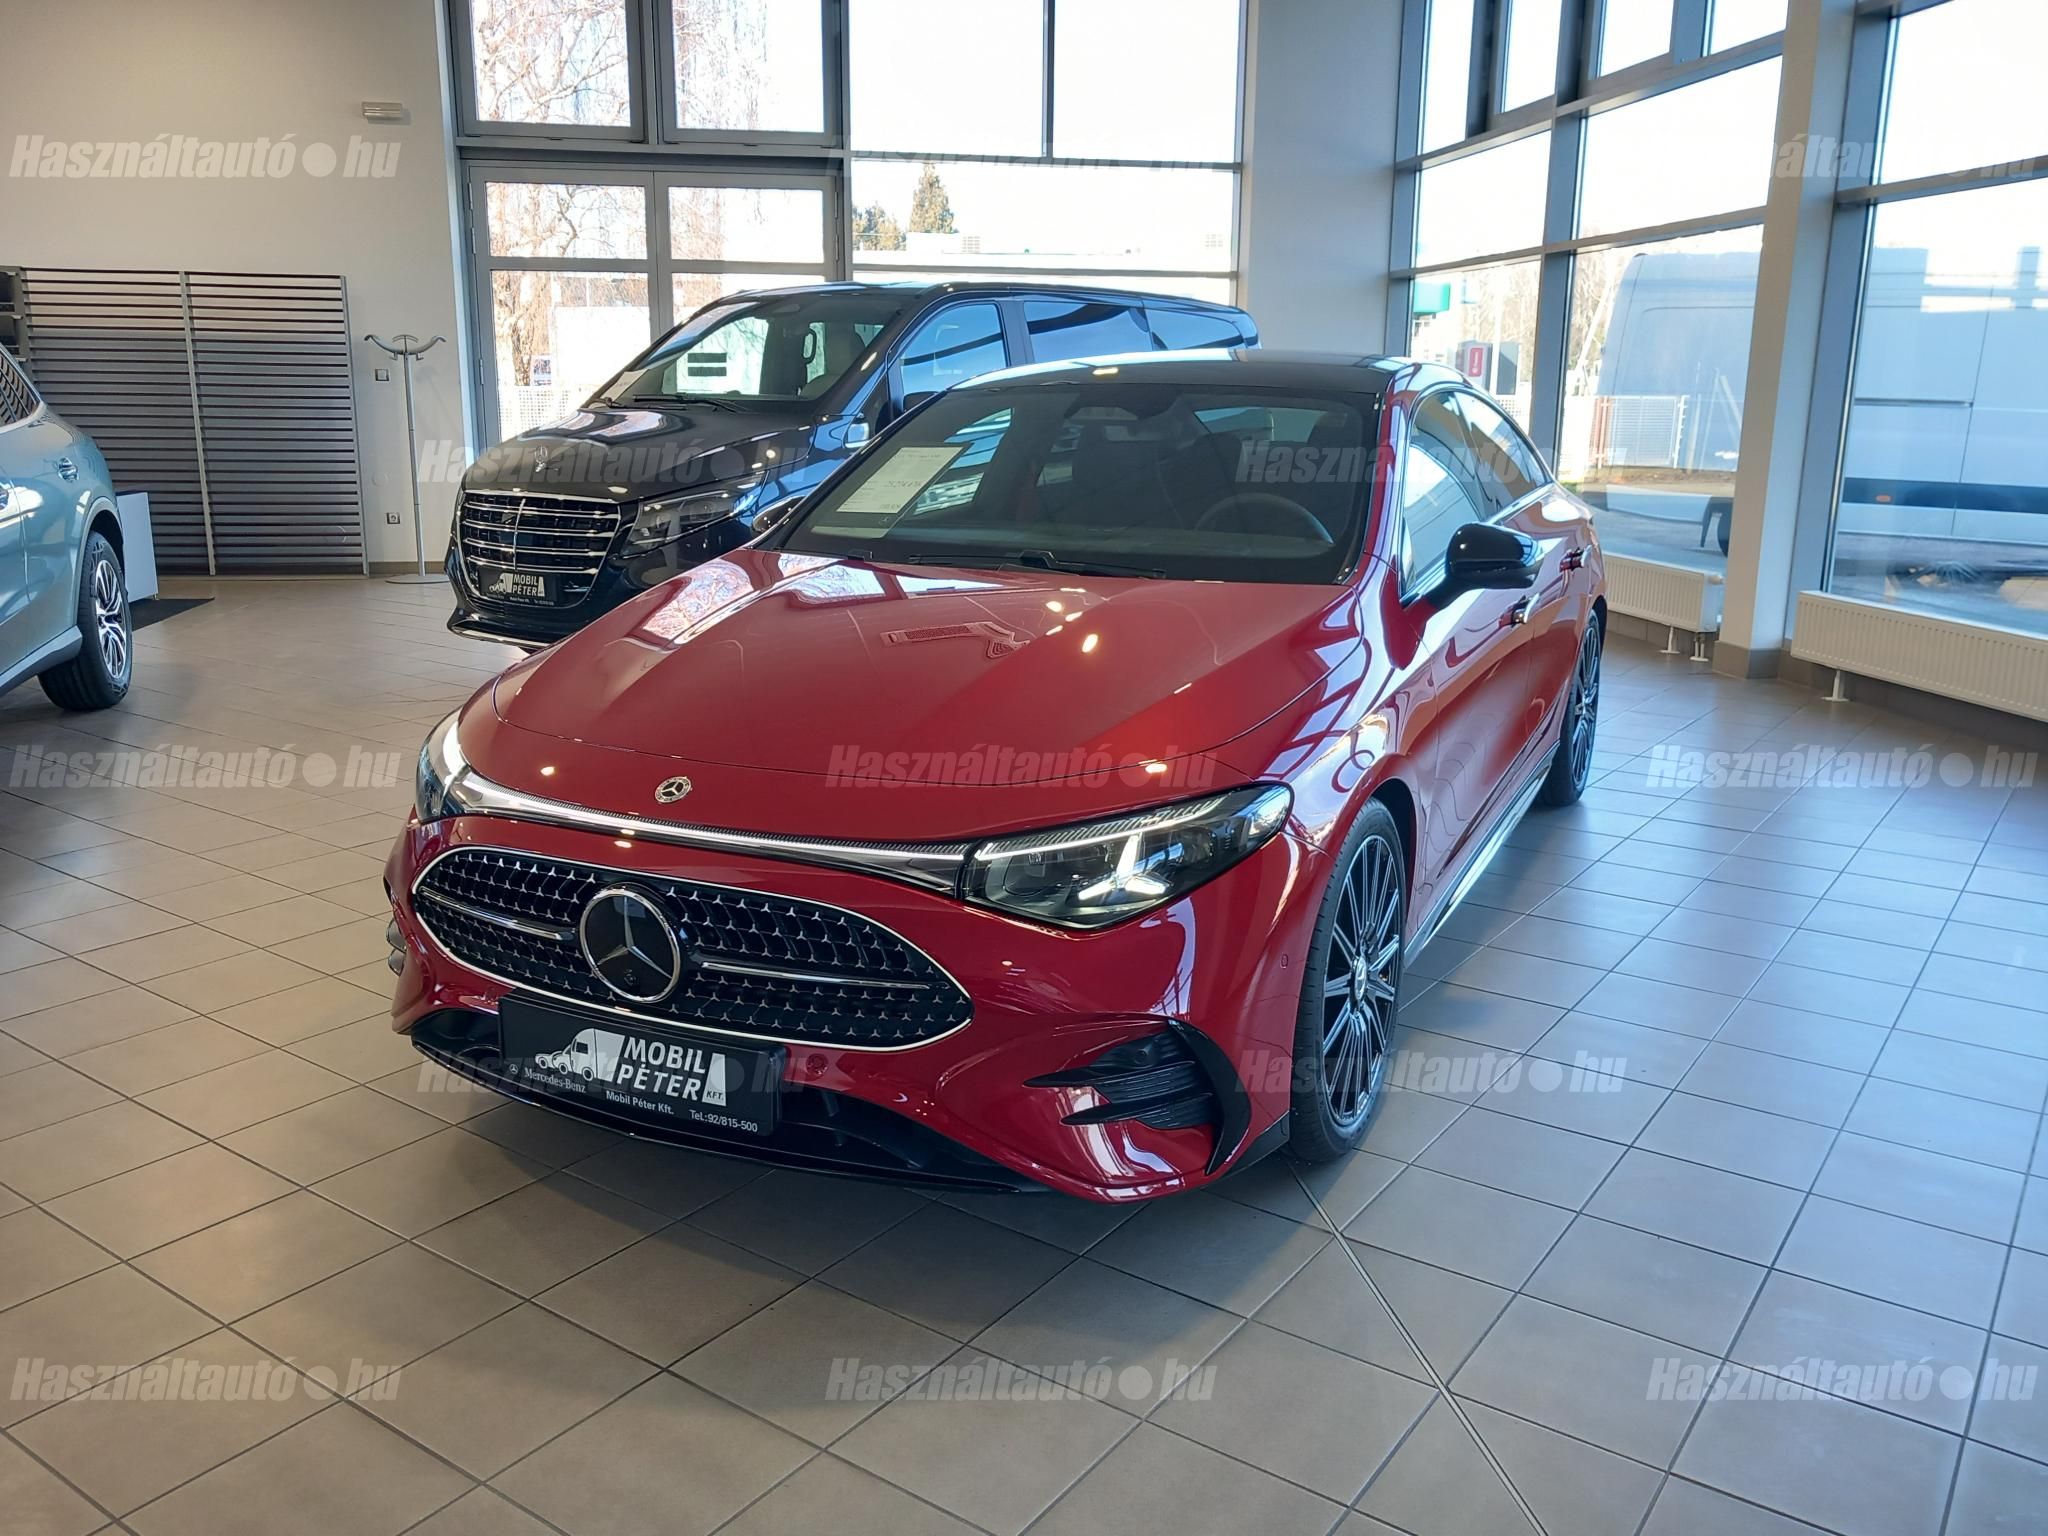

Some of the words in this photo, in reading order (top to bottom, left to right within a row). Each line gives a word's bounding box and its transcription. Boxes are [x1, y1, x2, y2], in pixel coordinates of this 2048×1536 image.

[512, 584, 537, 597] PÉTER
[513, 574, 538, 585] MOBIL
[624, 1036, 706, 1074] MOBIL
[524, 1067, 587, 1093] Mercedes-Benz
[616, 1063, 702, 1101] PÉTER
[606, 1090, 631, 1105] Mobil
[632, 1096, 656, 1111] Péter
[658, 1104, 675, 1115] Kft.
